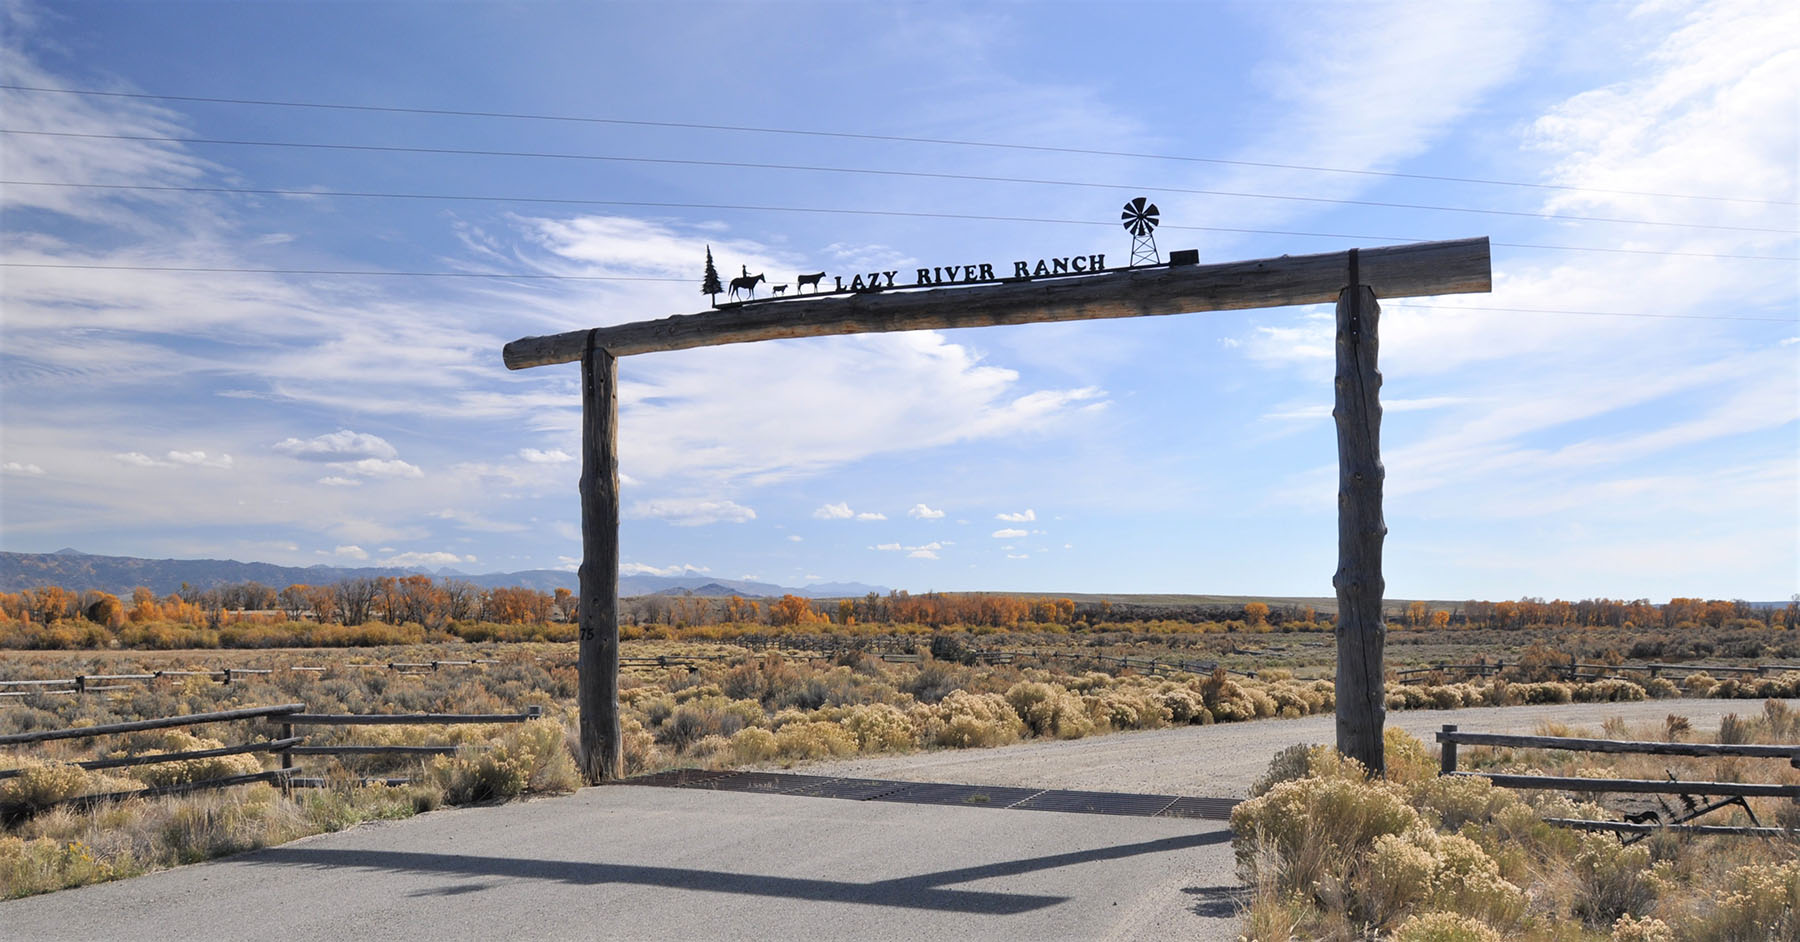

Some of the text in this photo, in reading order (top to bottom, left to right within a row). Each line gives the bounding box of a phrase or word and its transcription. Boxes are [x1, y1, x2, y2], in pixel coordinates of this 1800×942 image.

[834, 254, 1106, 292] LAZY RIVER RANCH
